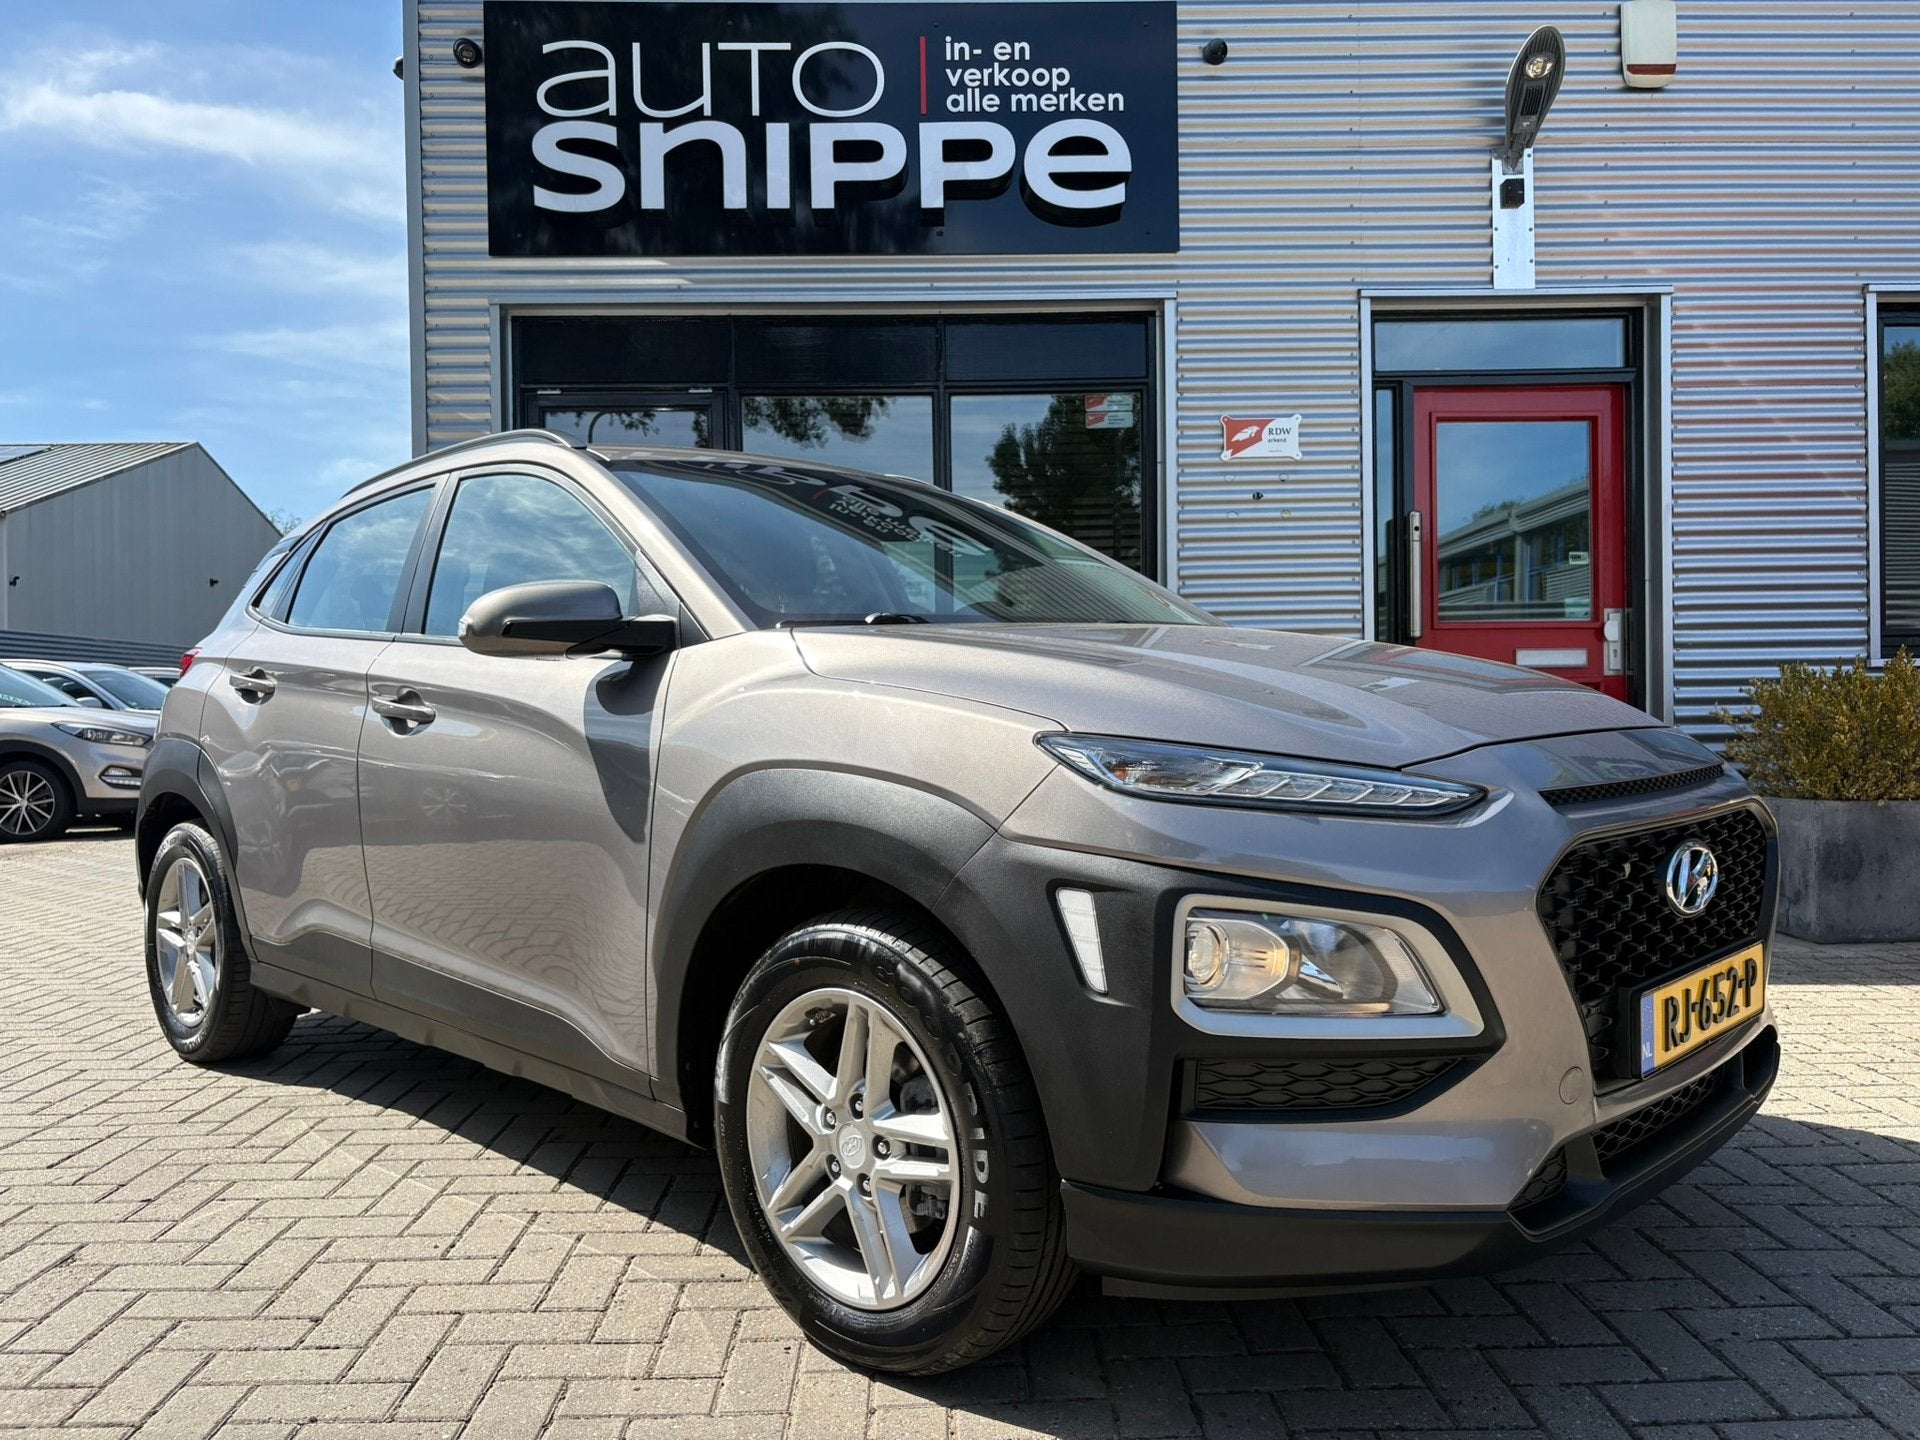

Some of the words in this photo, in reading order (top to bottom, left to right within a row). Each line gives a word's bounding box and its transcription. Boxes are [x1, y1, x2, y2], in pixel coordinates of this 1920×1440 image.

[945, 36, 982, 62] in-
[993, 41, 1030, 61] en
[946, 62, 1071, 94] verkoop
[946, 87, 1005, 113] alle
[1011, 87, 1124, 112] merken
[1268, 427, 1292, 435] RDW
[1662, 958, 1758, 1052] RJ-652-P
[1642, 1041, 1653, 1060] NL
